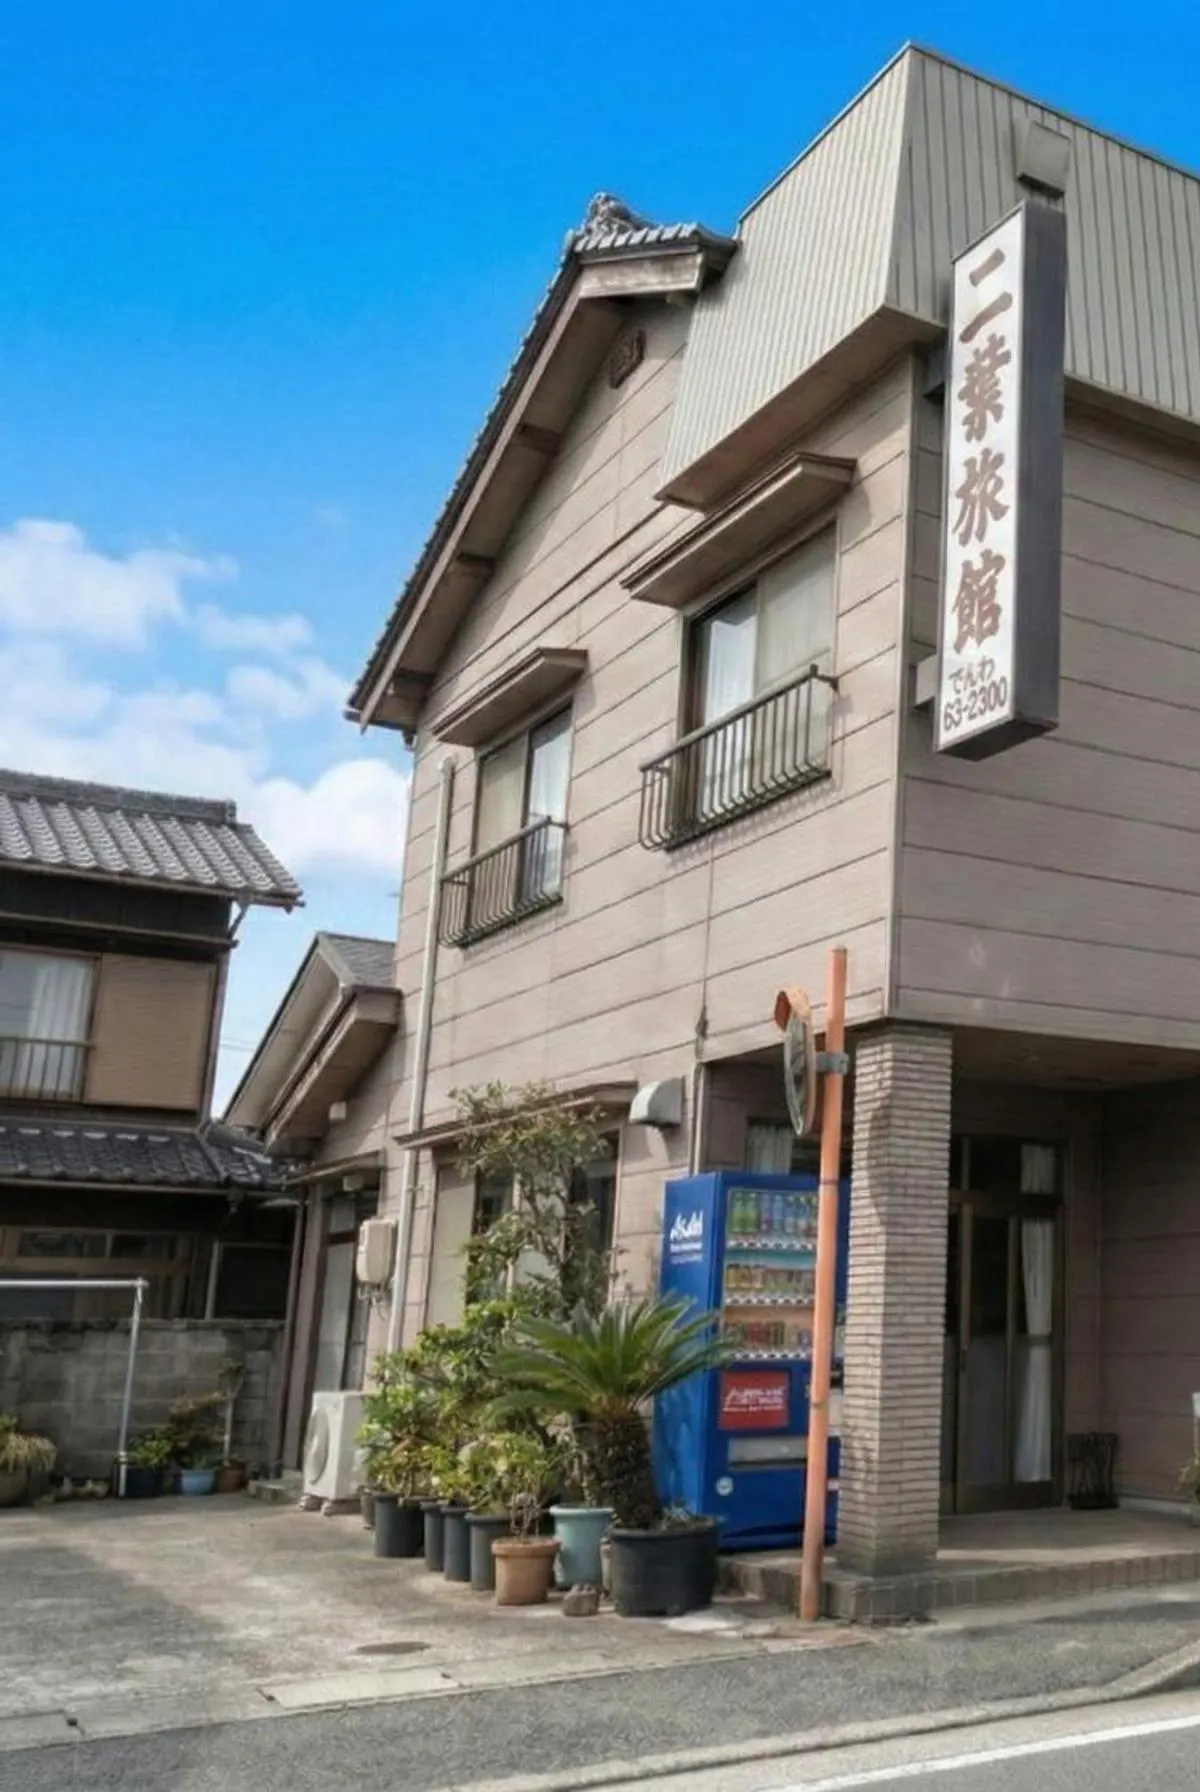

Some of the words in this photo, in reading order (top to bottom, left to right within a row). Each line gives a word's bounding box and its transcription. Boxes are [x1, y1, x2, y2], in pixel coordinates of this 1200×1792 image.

[952, 248, 1013, 654] 二葉旅館
[948, 654, 995, 694] でんわ
[944, 675, 1008, 731] 63-2300
